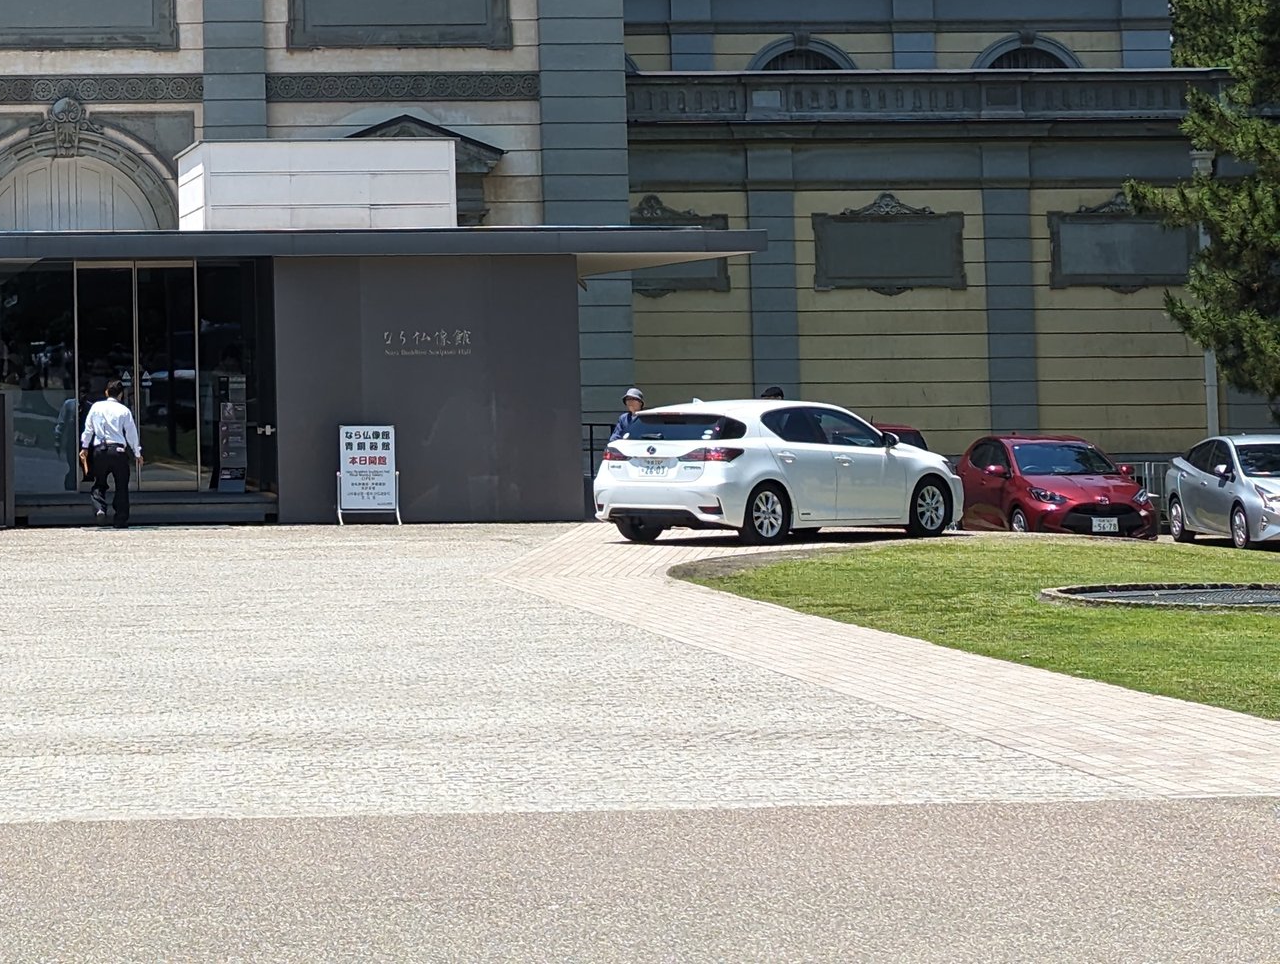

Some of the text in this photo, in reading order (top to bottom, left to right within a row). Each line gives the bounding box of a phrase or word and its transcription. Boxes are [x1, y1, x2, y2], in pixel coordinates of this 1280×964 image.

[383, 329, 471, 346] なら仏像館
[345, 431, 390, 440] なら仏像館
[345, 442, 390, 451] 青銅器館
[348, 456, 387, 466] 本日開館
